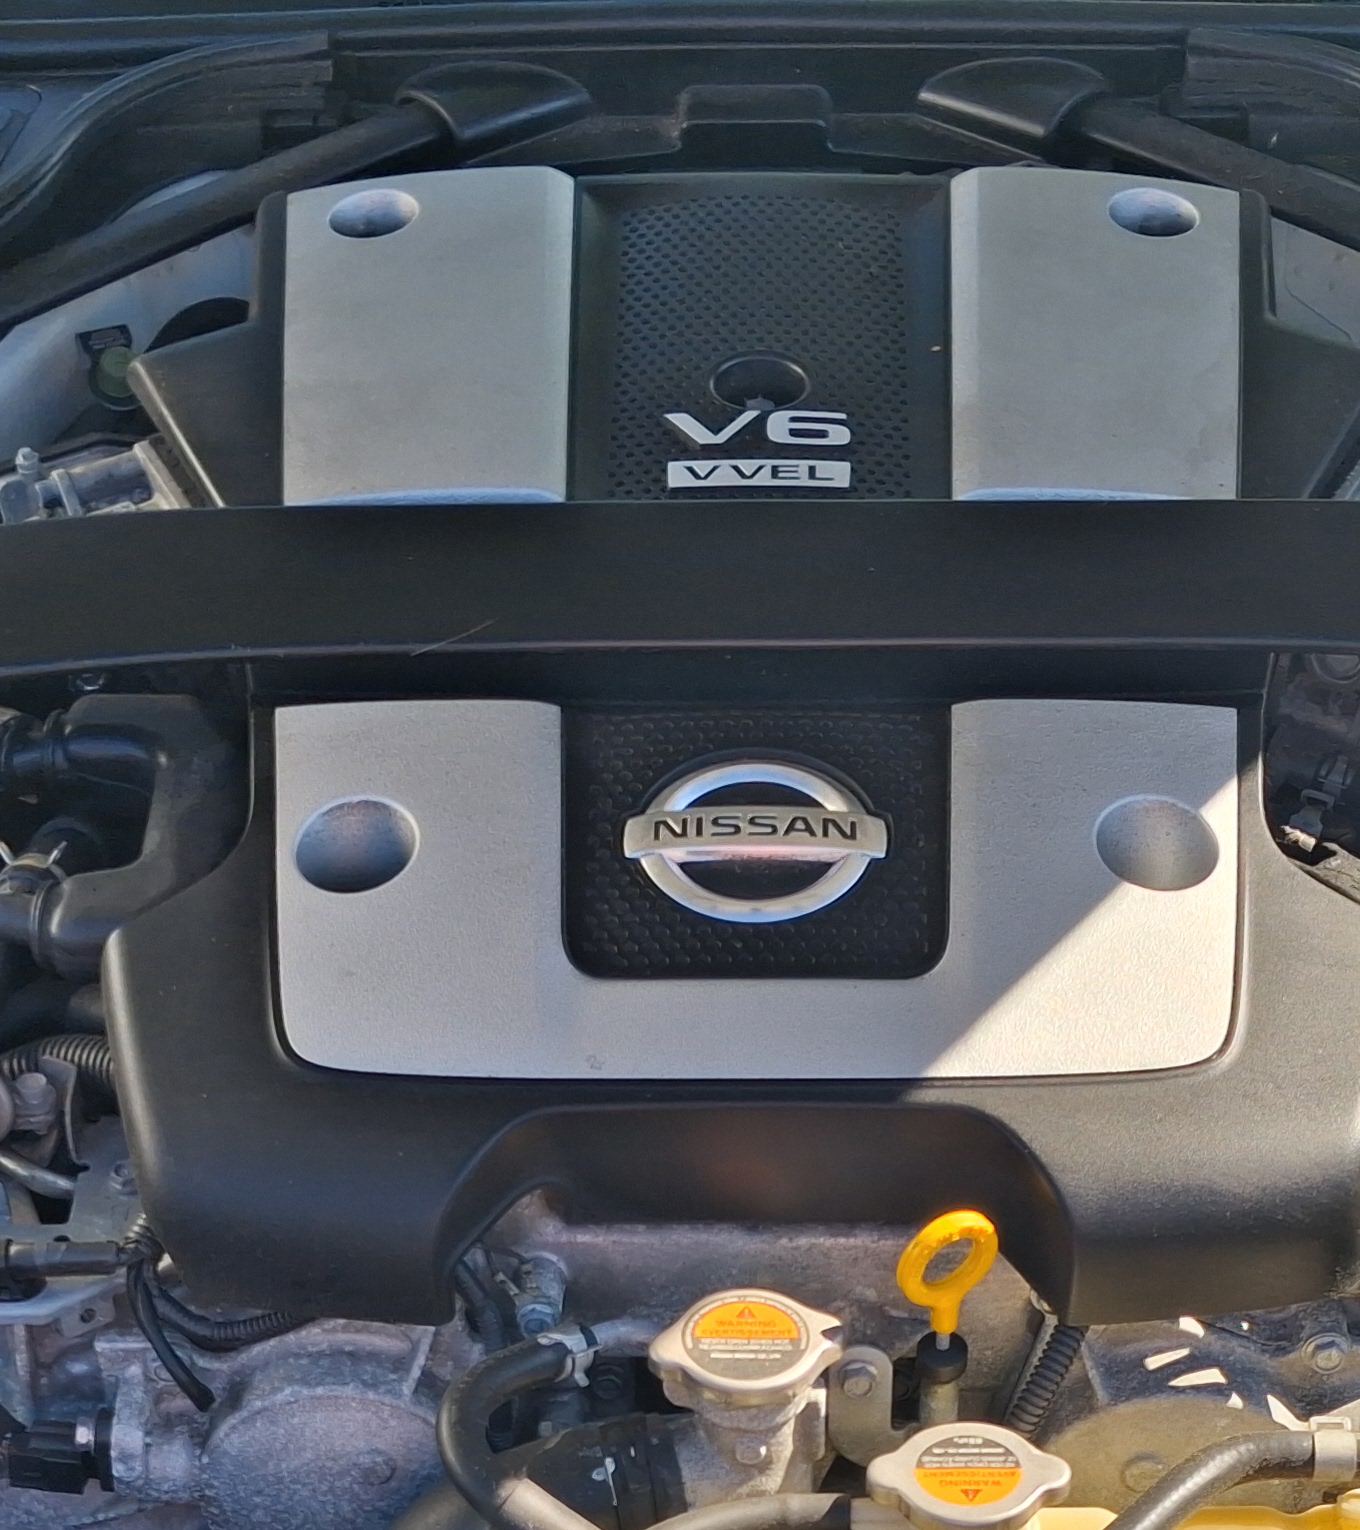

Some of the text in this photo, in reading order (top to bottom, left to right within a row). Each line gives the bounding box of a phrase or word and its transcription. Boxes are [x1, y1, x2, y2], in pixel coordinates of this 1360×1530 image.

[662, 409, 852, 446] V6
[683, 464, 836, 482] VVEL
[653, 815, 858, 842] NISSAN
[939, 1479, 1002, 1487] WARNING
